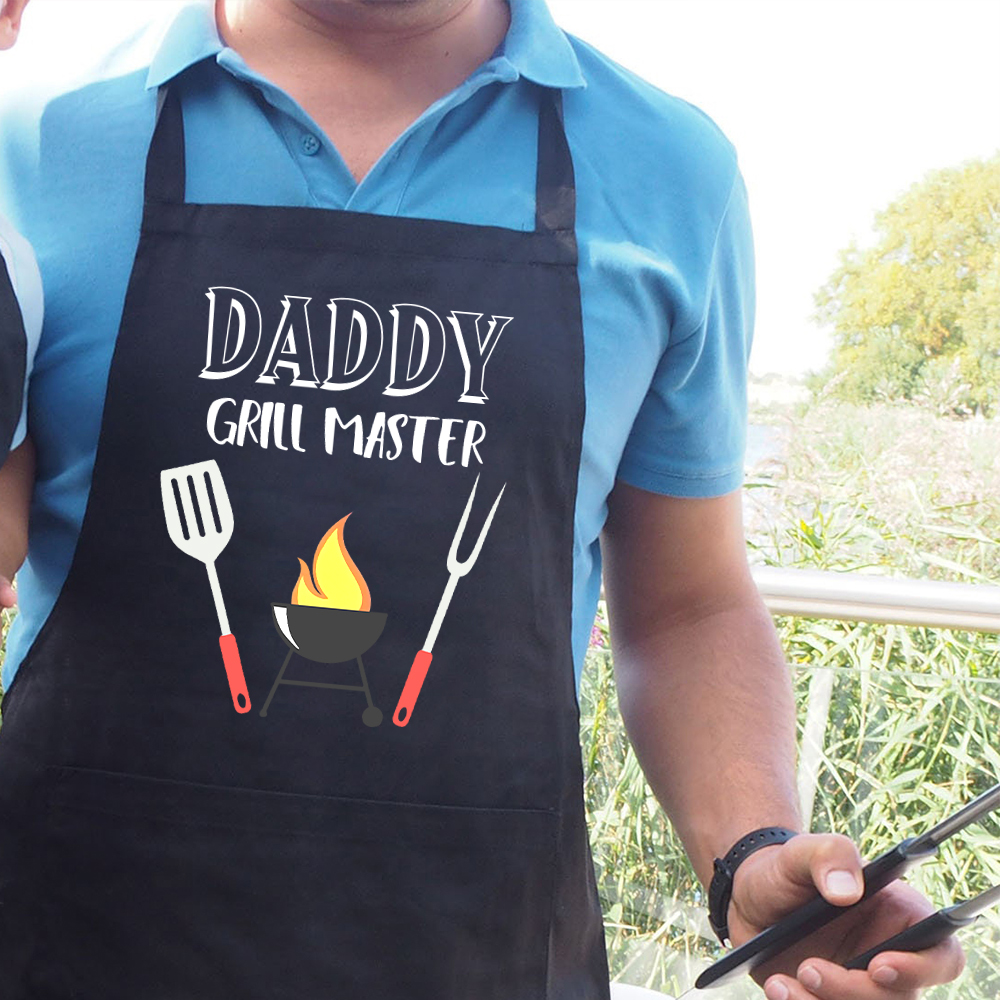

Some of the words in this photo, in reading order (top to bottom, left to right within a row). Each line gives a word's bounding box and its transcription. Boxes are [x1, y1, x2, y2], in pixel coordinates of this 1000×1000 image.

[198, 286, 514, 404] DADDY
[207, 398, 306, 452] GRILL
[325, 405, 486, 467] MASTER
